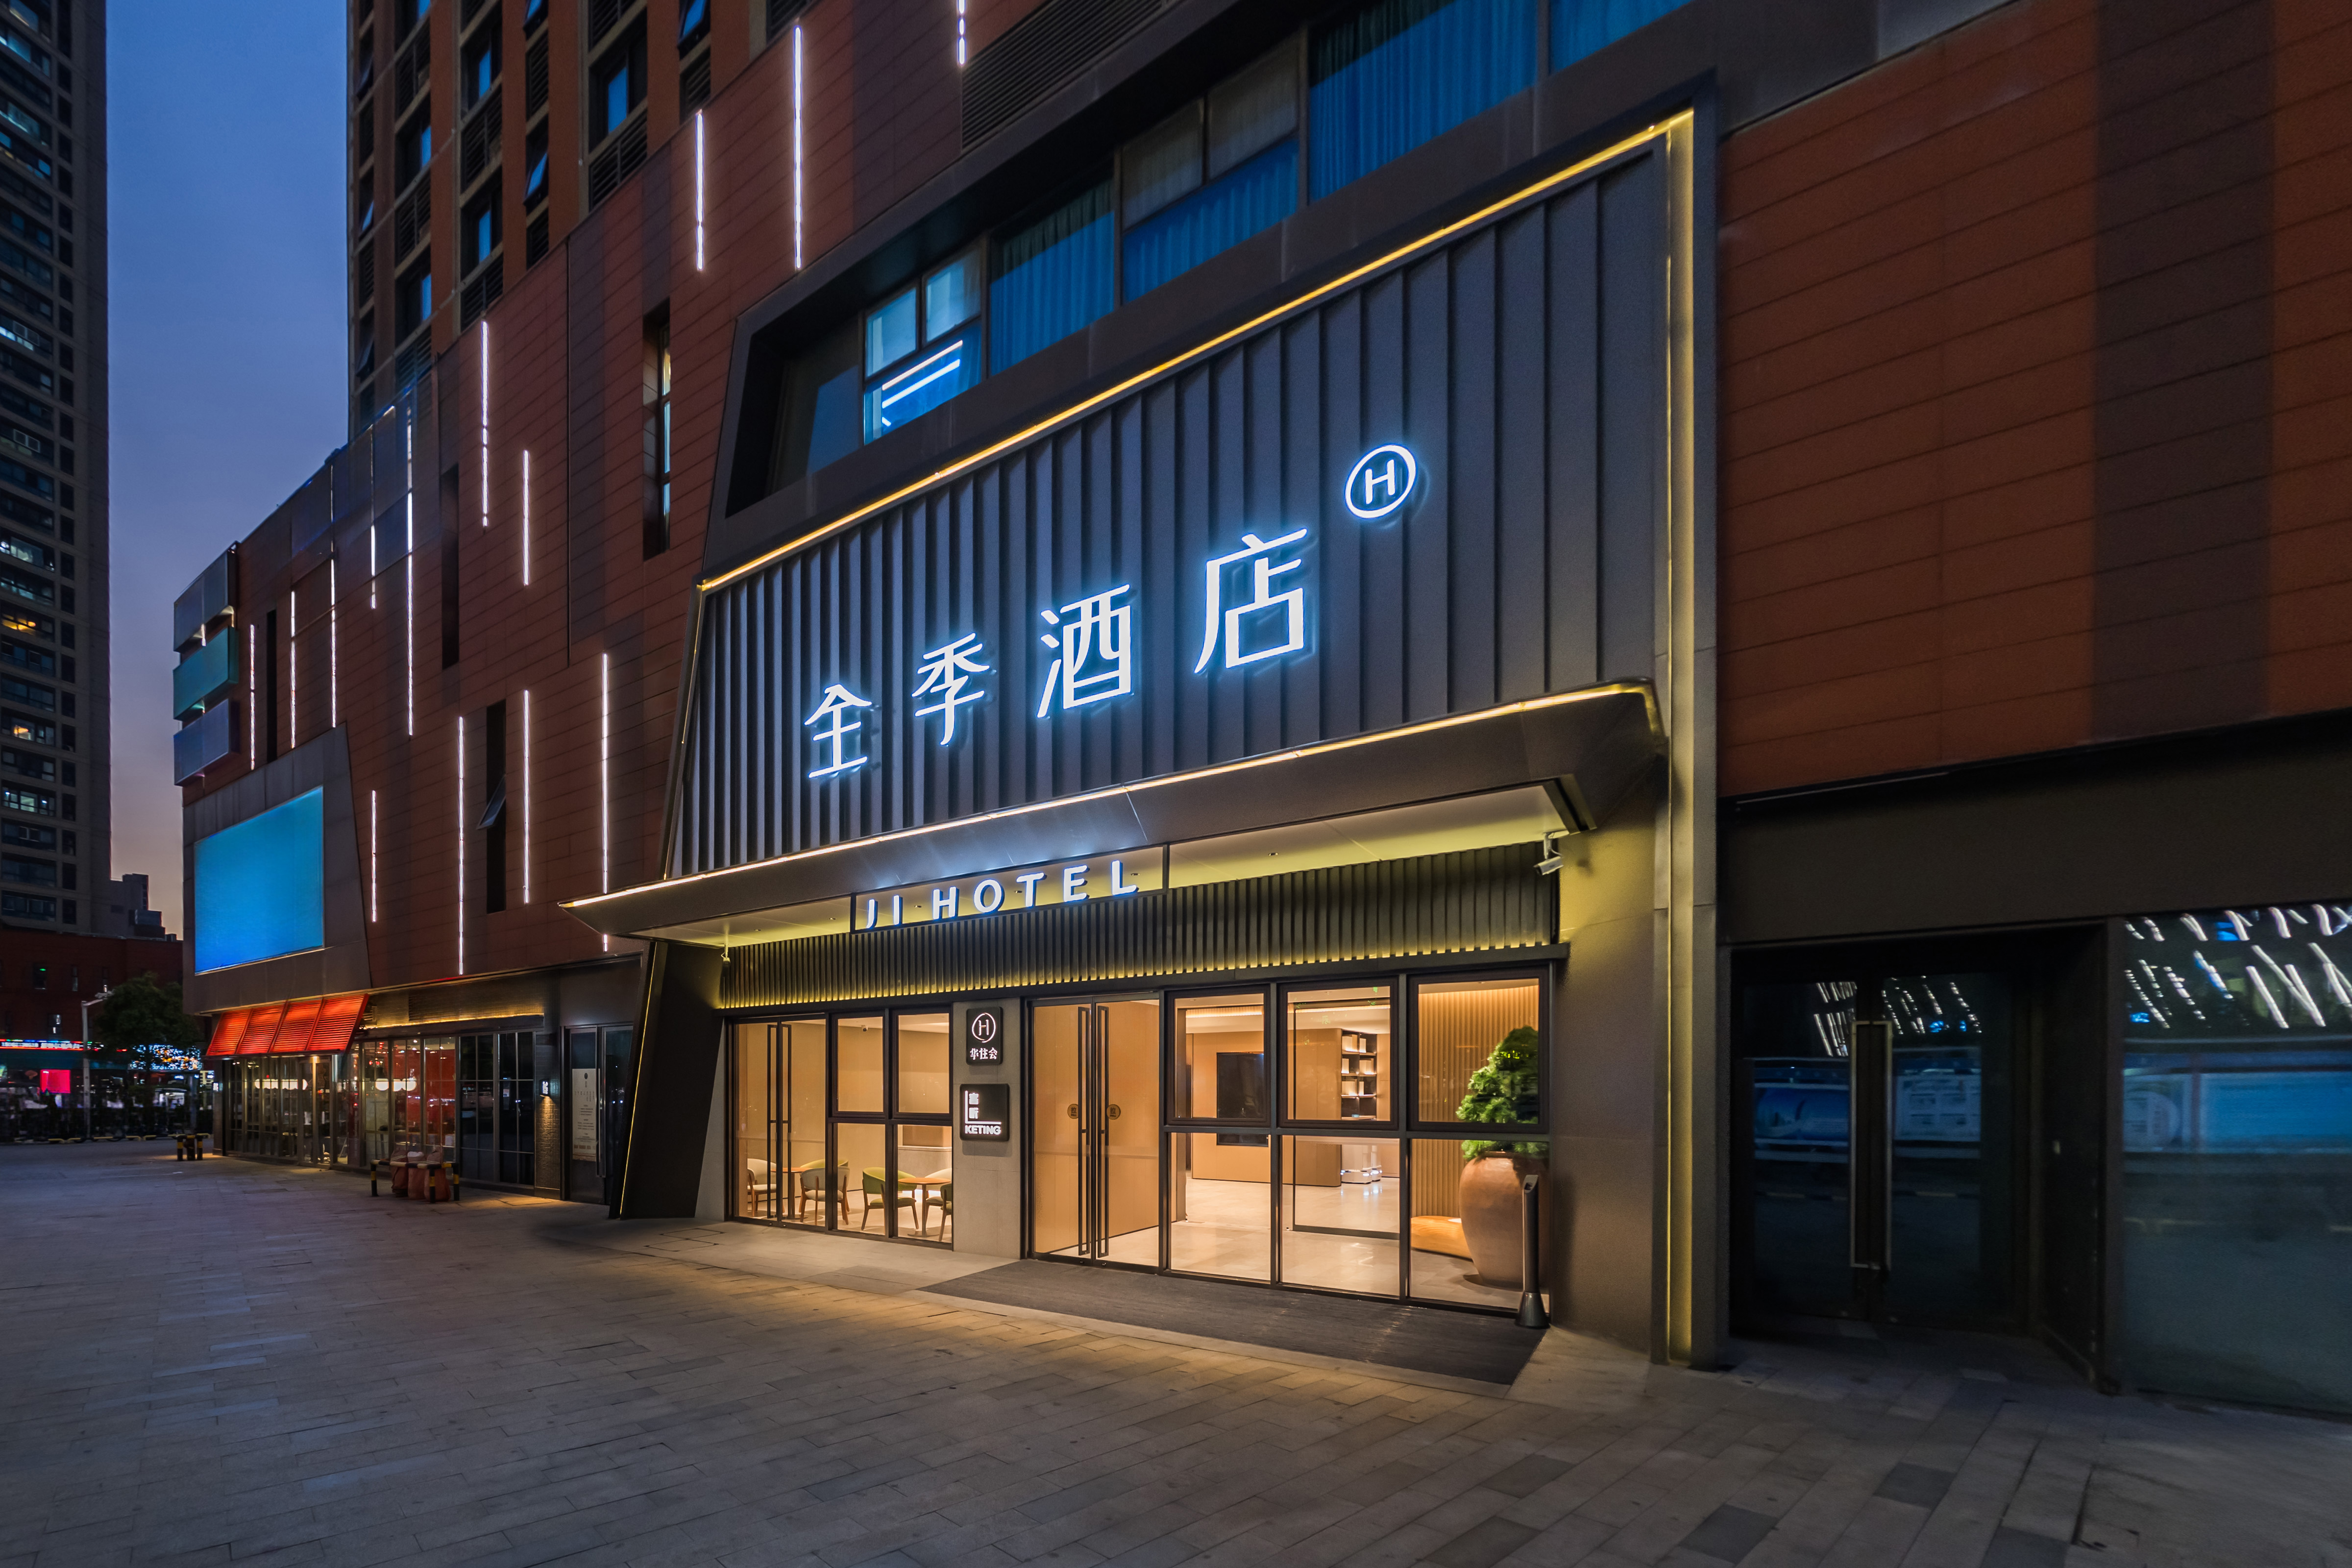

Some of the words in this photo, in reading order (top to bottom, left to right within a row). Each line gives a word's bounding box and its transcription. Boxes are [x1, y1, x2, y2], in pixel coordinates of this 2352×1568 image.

[804, 528, 1308, 779] 全季酒店
[866, 895, 901, 929] JI
[932, 860, 1137, 920] HOTEL
[970, 1047, 998, 1060] 华住会
[965, 1125, 1001, 1135] KETING
